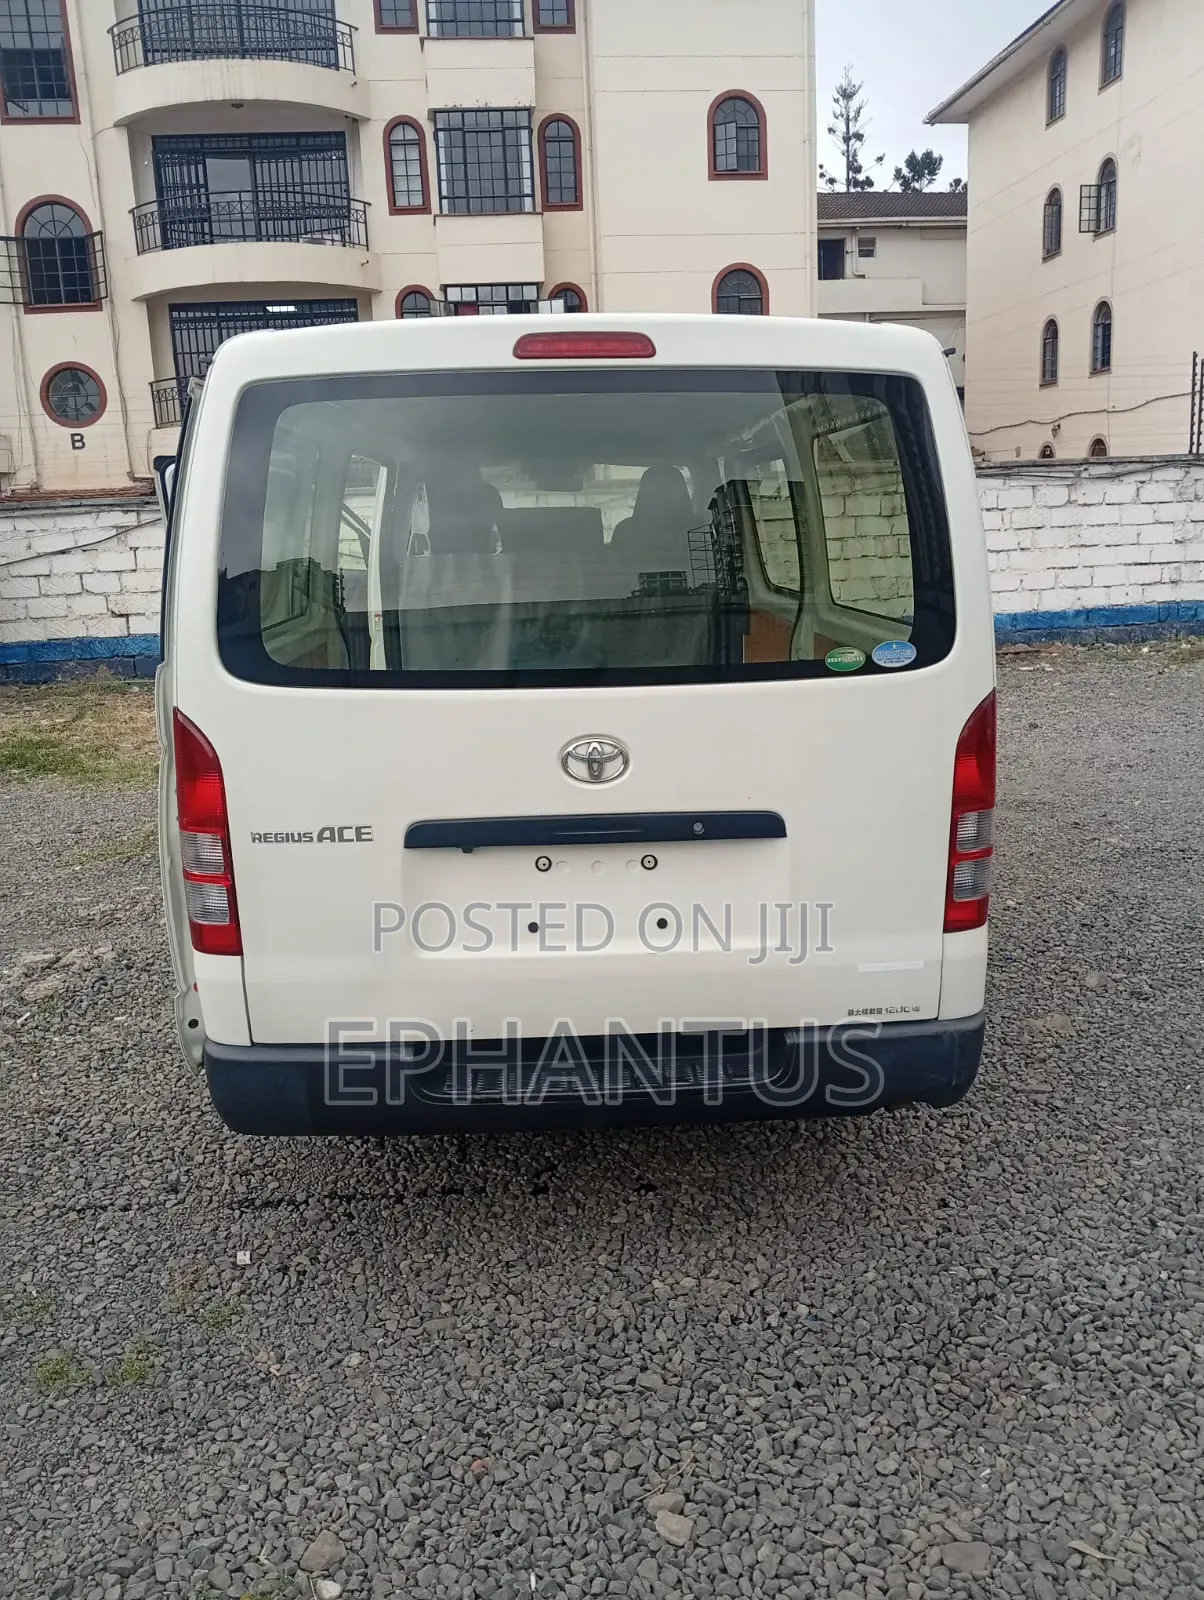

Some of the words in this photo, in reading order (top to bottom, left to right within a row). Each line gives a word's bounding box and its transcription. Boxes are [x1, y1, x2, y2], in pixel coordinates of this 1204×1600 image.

[70, 433, 86, 450] B
[250, 831, 314, 844] REGIUS
[317, 825, 374, 843] ACE
